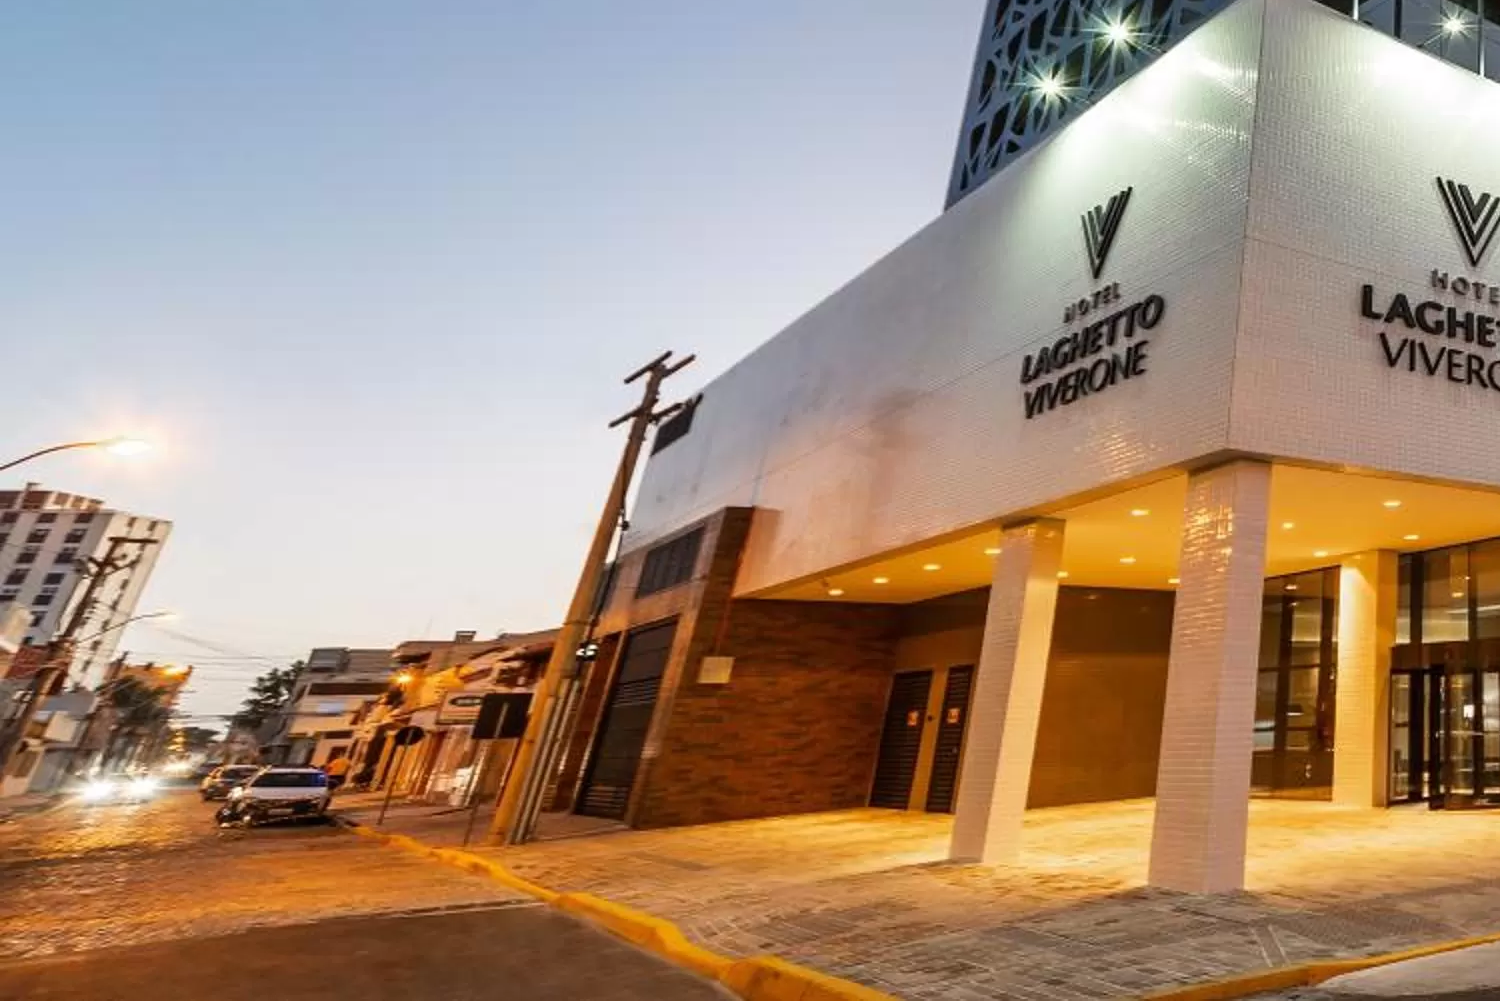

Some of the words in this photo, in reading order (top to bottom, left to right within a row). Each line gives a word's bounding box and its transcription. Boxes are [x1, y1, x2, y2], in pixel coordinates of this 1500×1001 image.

[1020, 294, 1165, 384] LAGHETTO
[1063, 282, 1121, 324] HOTEL
[1024, 340, 1149, 419] VIVERONE
